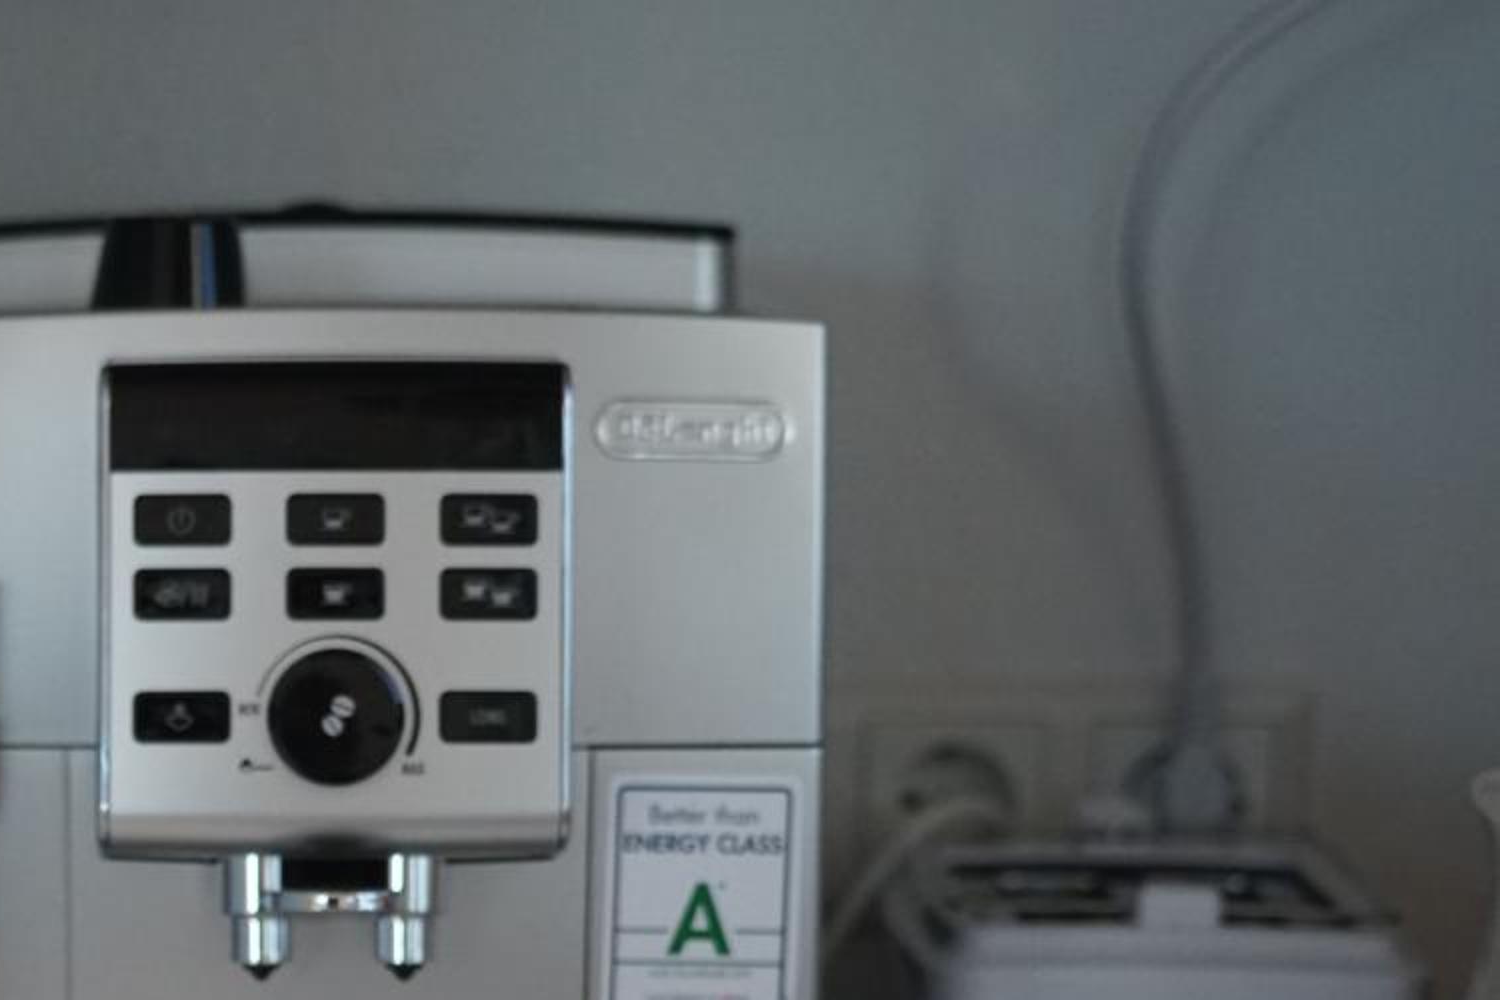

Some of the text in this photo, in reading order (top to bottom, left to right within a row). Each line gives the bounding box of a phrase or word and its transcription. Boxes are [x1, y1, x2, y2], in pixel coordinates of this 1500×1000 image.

[648, 804, 761, 826] Better than
[621, 832, 784, 855] ENERGY CLASS
[667, 882, 730, 955] A
